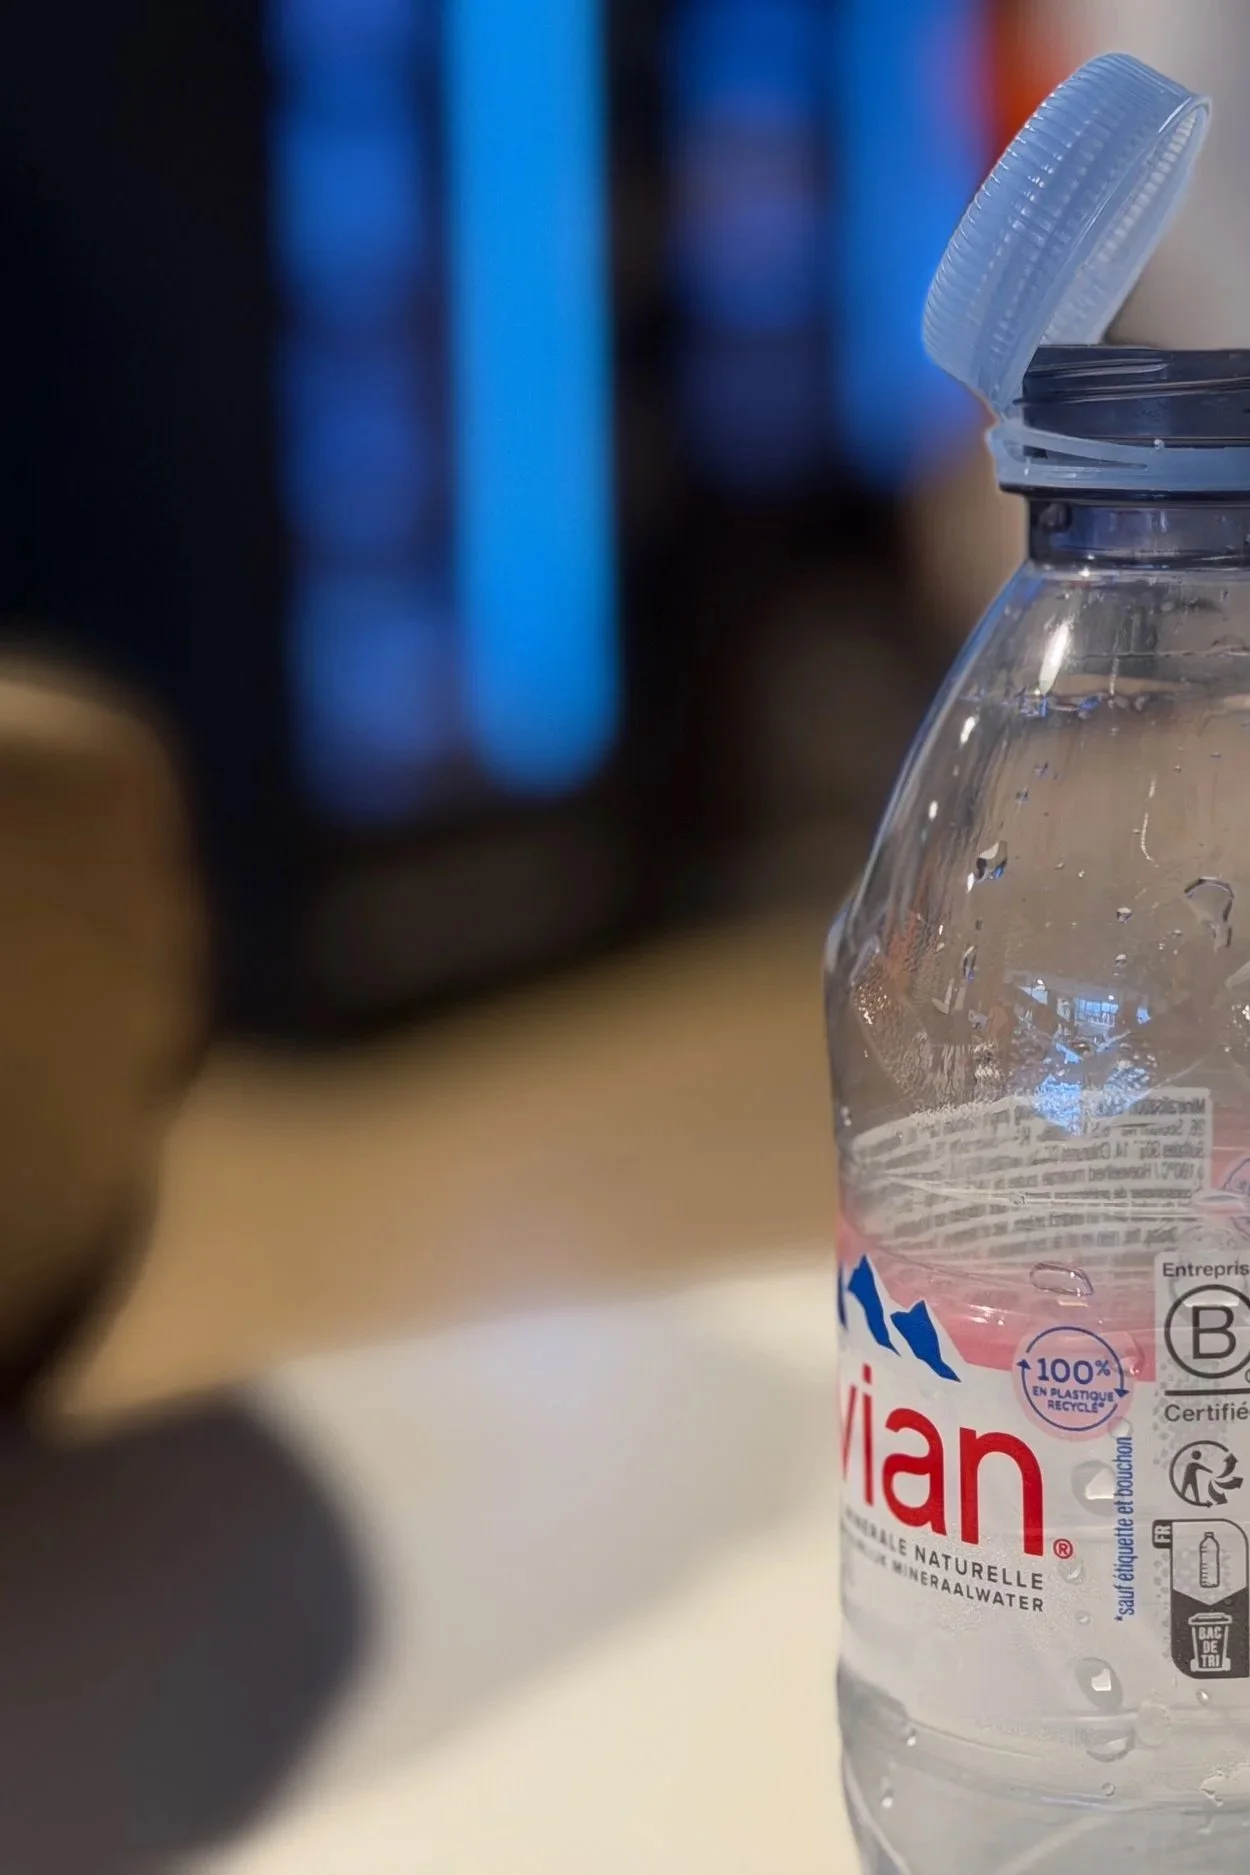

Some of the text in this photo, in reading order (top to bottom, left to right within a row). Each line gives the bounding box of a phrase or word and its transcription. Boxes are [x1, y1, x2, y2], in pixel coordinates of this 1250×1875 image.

[1192, 1305, 1236, 1359] B
[1037, 1358, 1111, 1385] 100%
[1032, 1386, 1114, 1402] EN PLASTIQUE
[1112, 1436, 1133, 1496] bouchon
[1113, 1500, 1134, 1515] et
[1154, 1524, 1172, 1543] FR
[1112, 1518, 1138, 1581] étiquette
[914, 1544, 1044, 1591] NATURELLE
[892, 1560, 1044, 1613] MINERAALWATER
[1199, 1627, 1222, 1639] BAC
[1203, 1640, 1217, 1653] DE
[1201, 1655, 1220, 1667] TRI
